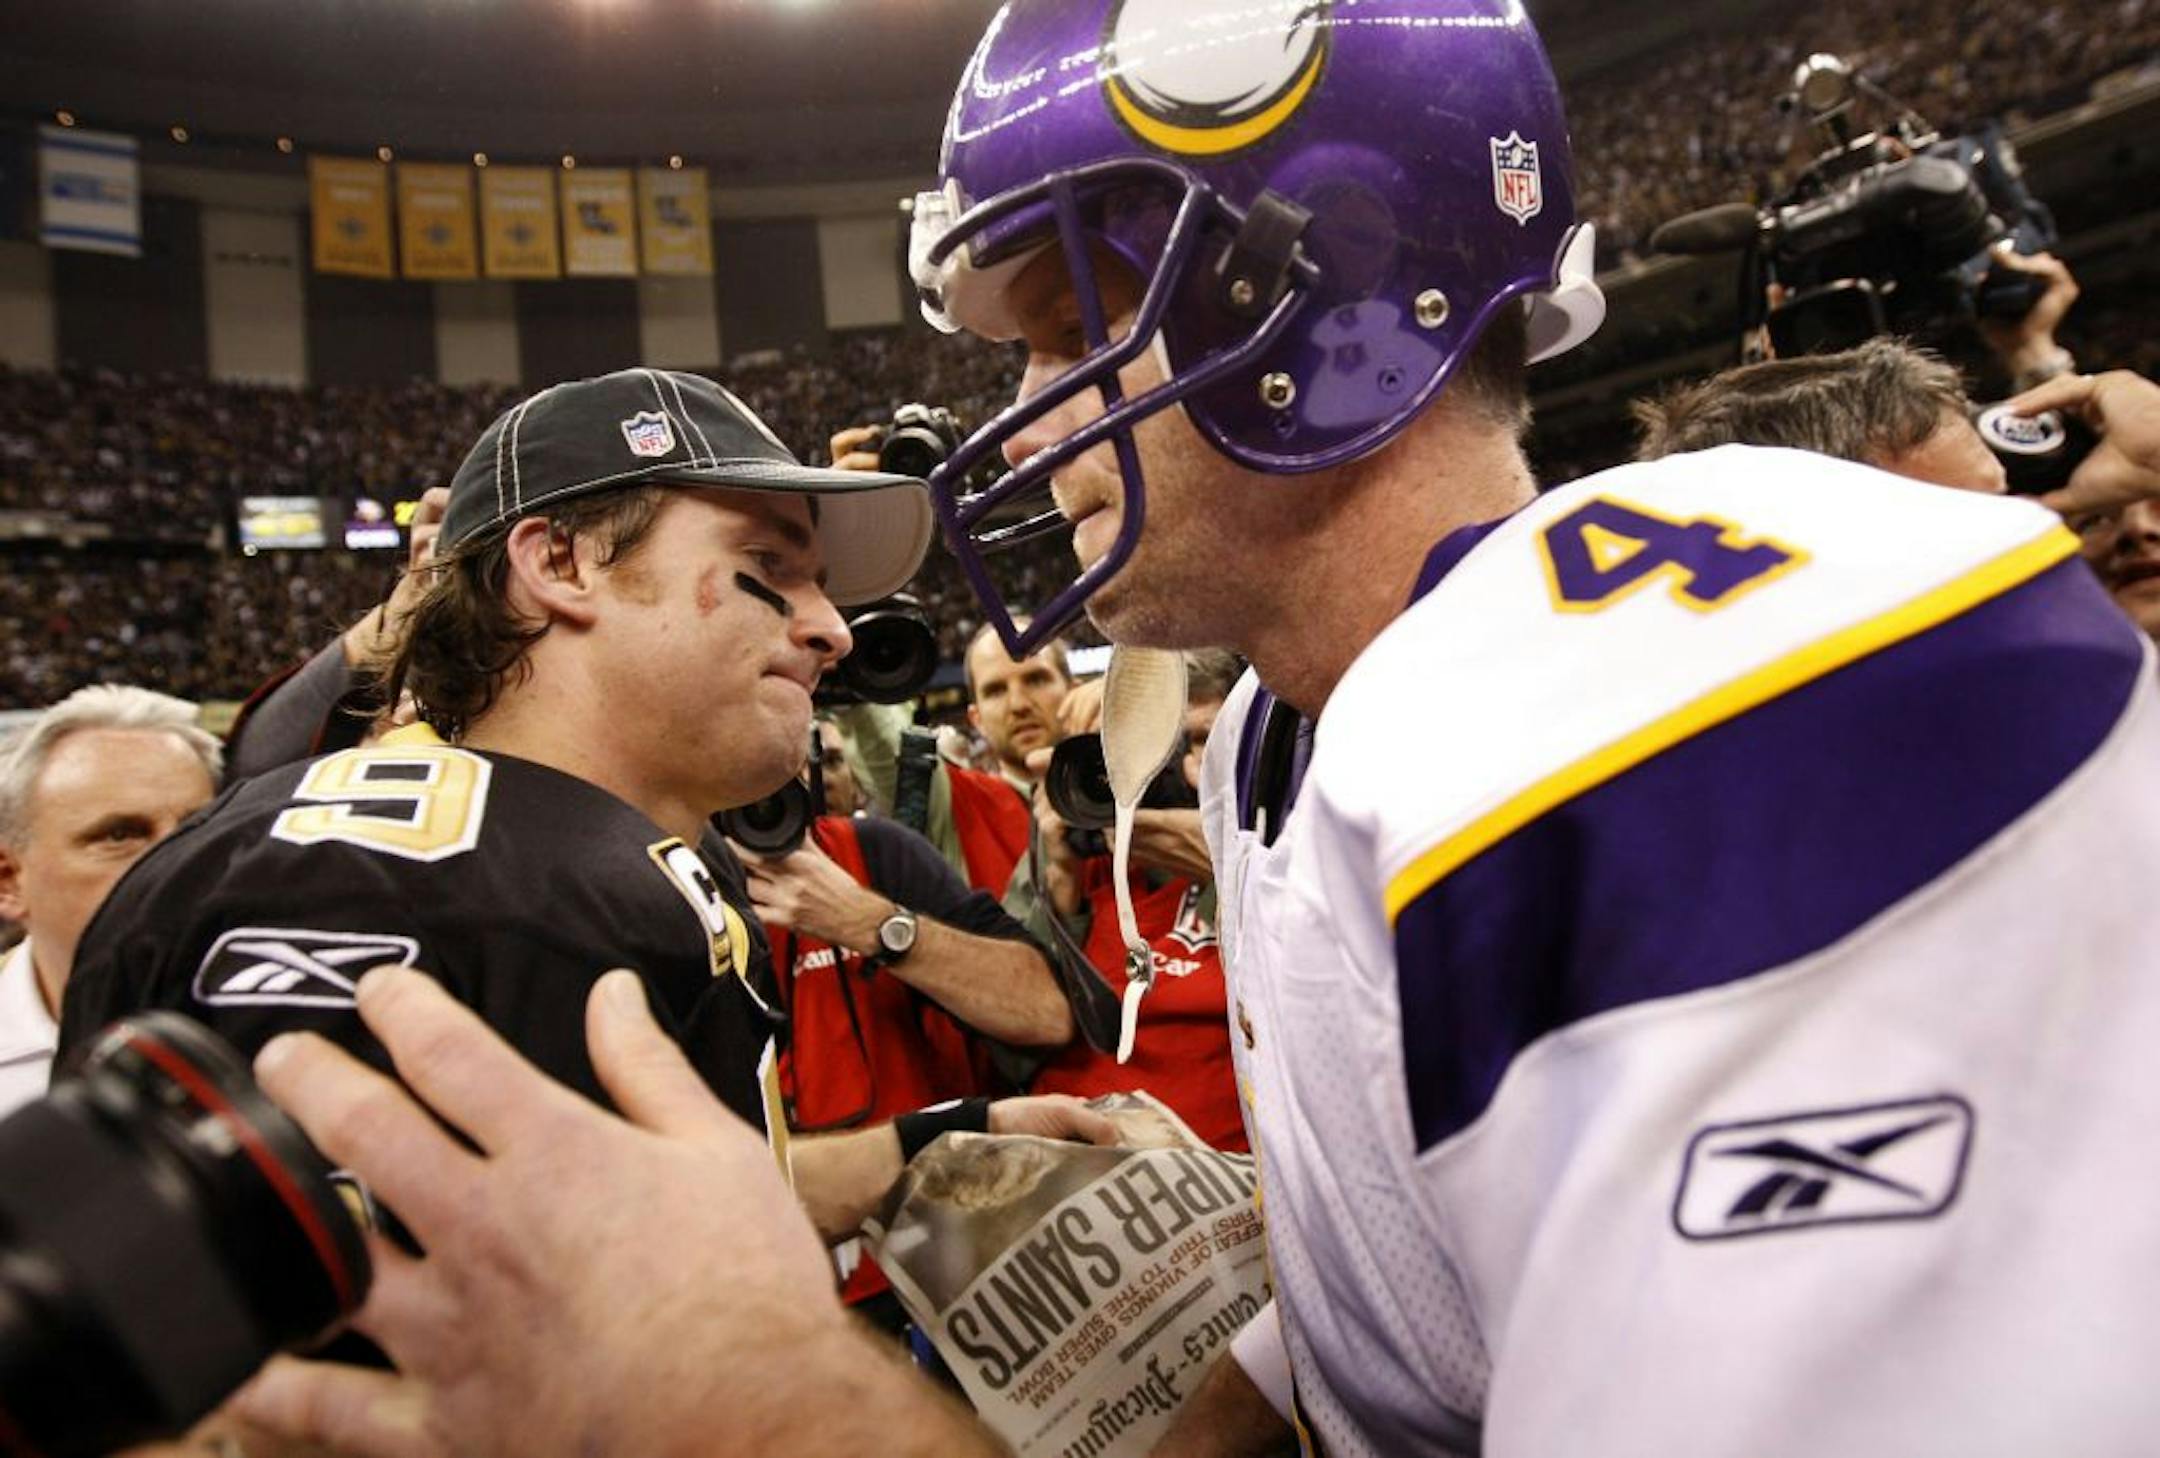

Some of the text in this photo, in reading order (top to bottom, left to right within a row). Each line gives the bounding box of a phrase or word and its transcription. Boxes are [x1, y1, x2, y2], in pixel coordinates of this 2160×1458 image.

[1502, 172, 1536, 207] NFL
[638, 436, 669, 453] NFL
[1536, 494, 1812, 614] 4
[270, 745, 492, 862] 9
[1212, 1209, 1256, 1235] FIRST
[1215, 1220, 1264, 1252] EFEAT
[1169, 1230, 1209, 1265] TRIP
[1191, 1246, 1212, 1270] OF
[1140, 1262, 1168, 1285] TO
[946, 1206, 1121, 1390] SAINTS
[1103, 1282, 1141, 1318] THE
[1118, 1267, 1187, 1327] VIKINGS
[1055, 1313, 1106, 1363] SUPER
[1074, 1324, 1117, 1367] GIVES
[1006, 1359, 1056, 1405] BOWL
[1029, 1366, 1076, 1409] TEAM
